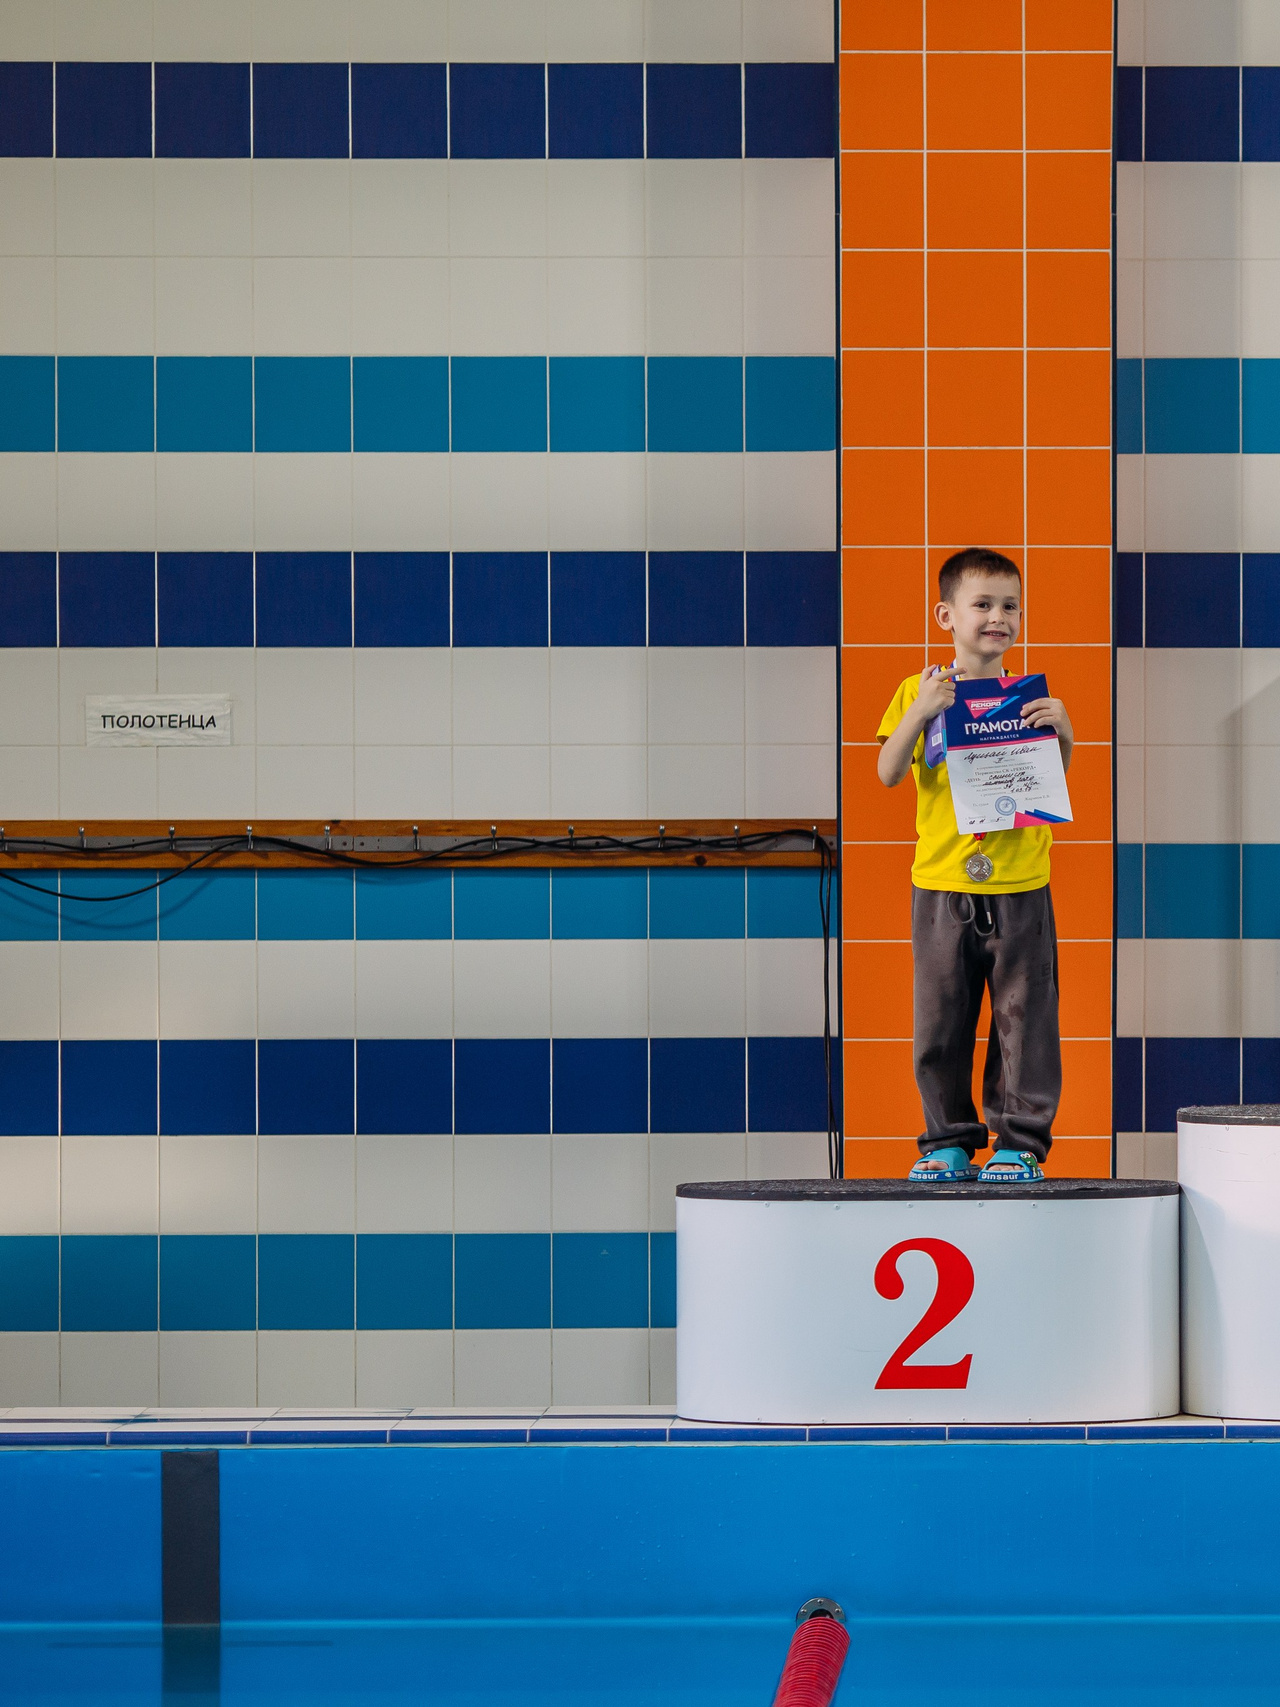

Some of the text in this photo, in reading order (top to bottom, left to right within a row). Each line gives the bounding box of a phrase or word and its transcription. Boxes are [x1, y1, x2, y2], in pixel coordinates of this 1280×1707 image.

[101, 714, 217, 730] ПОЛОТЕНЦА
[981, 1173, 1019, 1181] Dinsaur
[874, 1238, 975, 1390] 2
